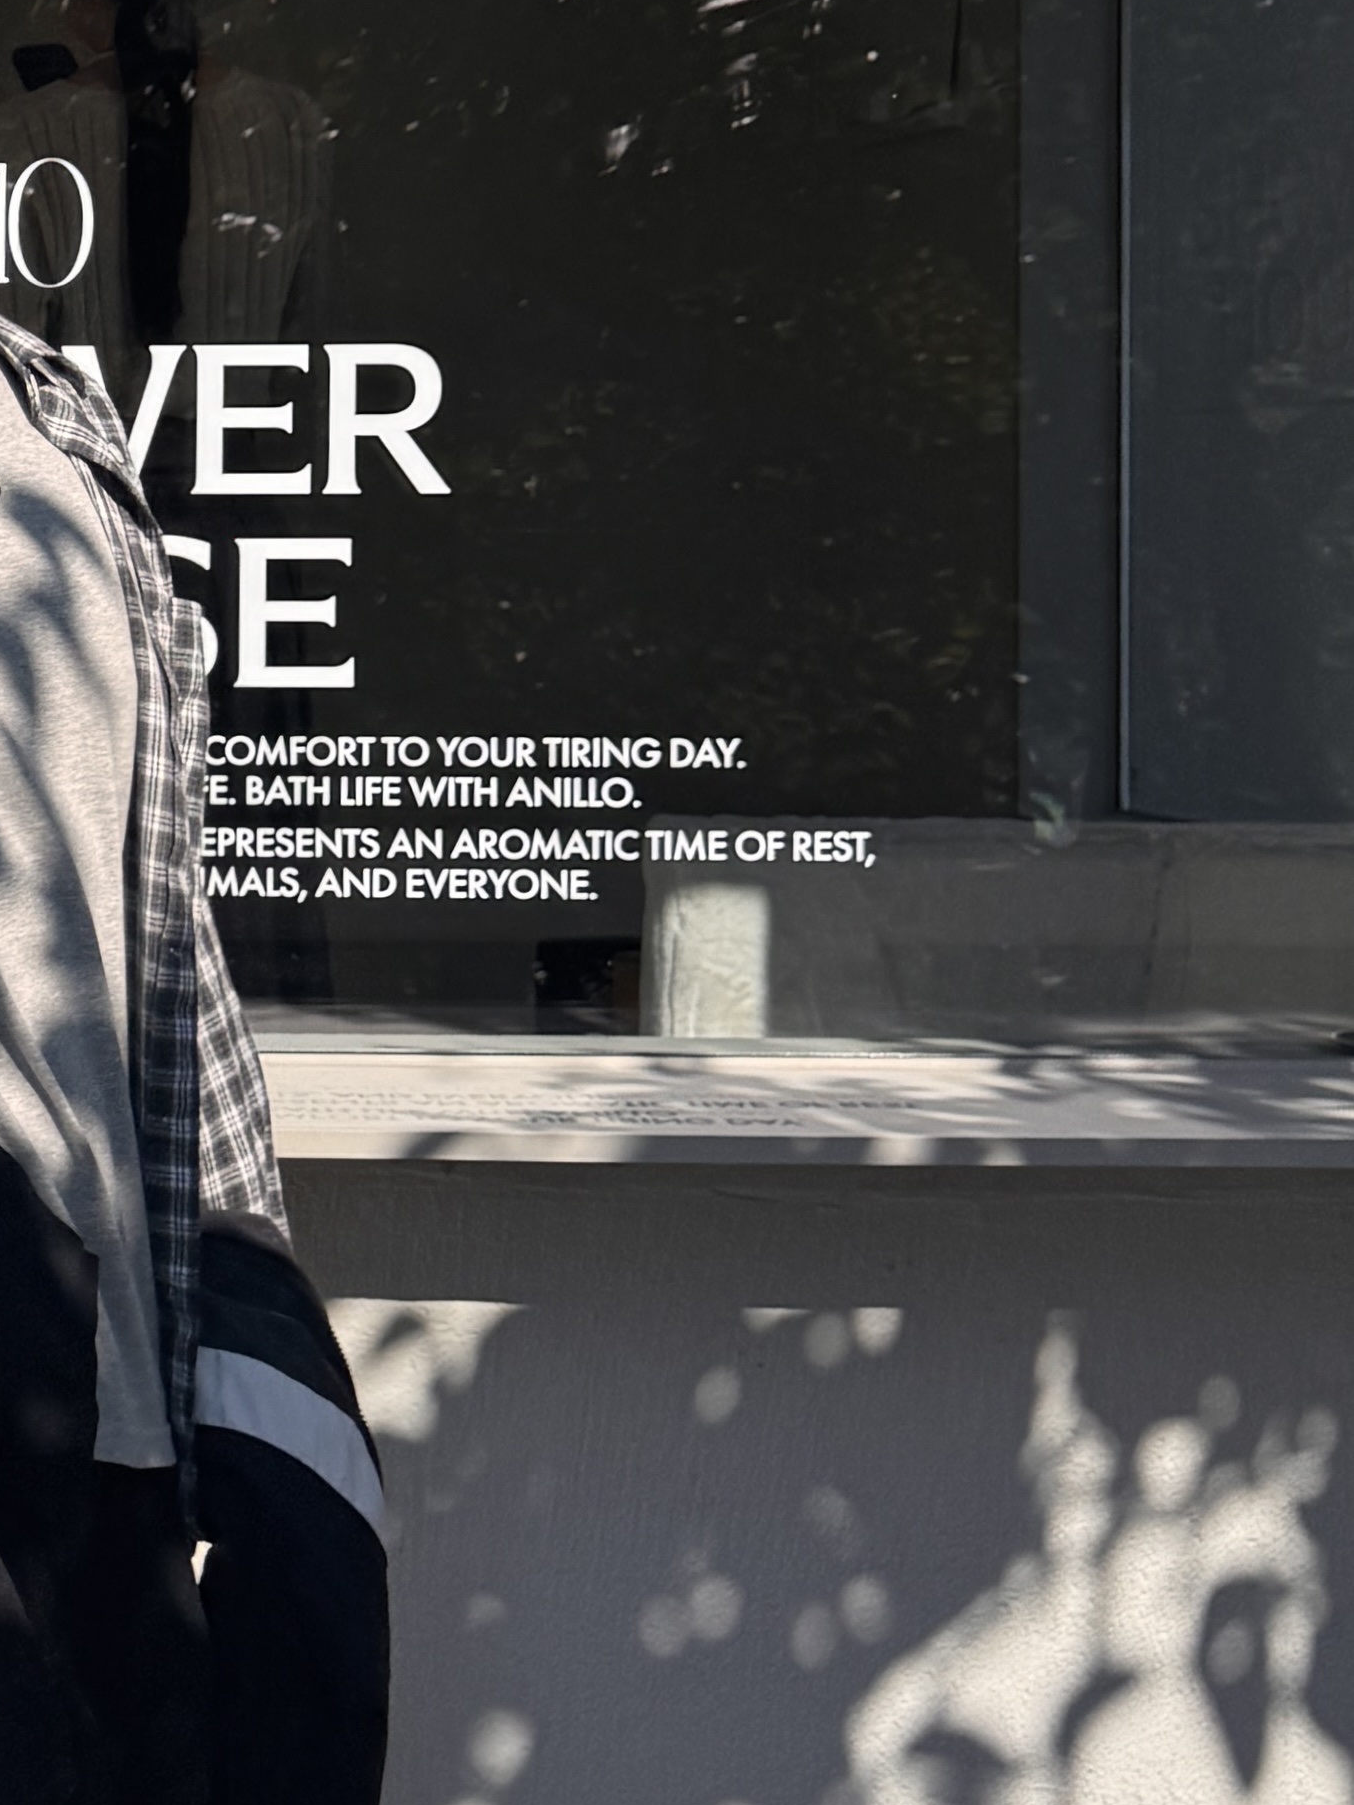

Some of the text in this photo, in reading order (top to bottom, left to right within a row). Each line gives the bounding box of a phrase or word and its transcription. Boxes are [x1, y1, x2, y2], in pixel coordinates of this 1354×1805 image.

[205, 735, 377, 767] COMFORT
[380, 736, 431, 768] TO
[436, 736, 538, 768] YOUR
[542, 737, 662, 769] TIRING
[669, 737, 748, 770] DAY.
[245, 775, 331, 806] BATH
[340, 776, 402, 807] LIFE
[408, 776, 499, 808] WITH
[505, 776, 643, 809] ANILLO.
[386, 828, 443, 859] AN
[450, 828, 640, 861] AROMATIC
[644, 829, 729, 861] TIME
[734, 830, 786, 862] OF
[792, 831, 876, 869] REST,
[314, 867, 398, 899] AND
[406, 868, 599, 901] EVERYONE.
